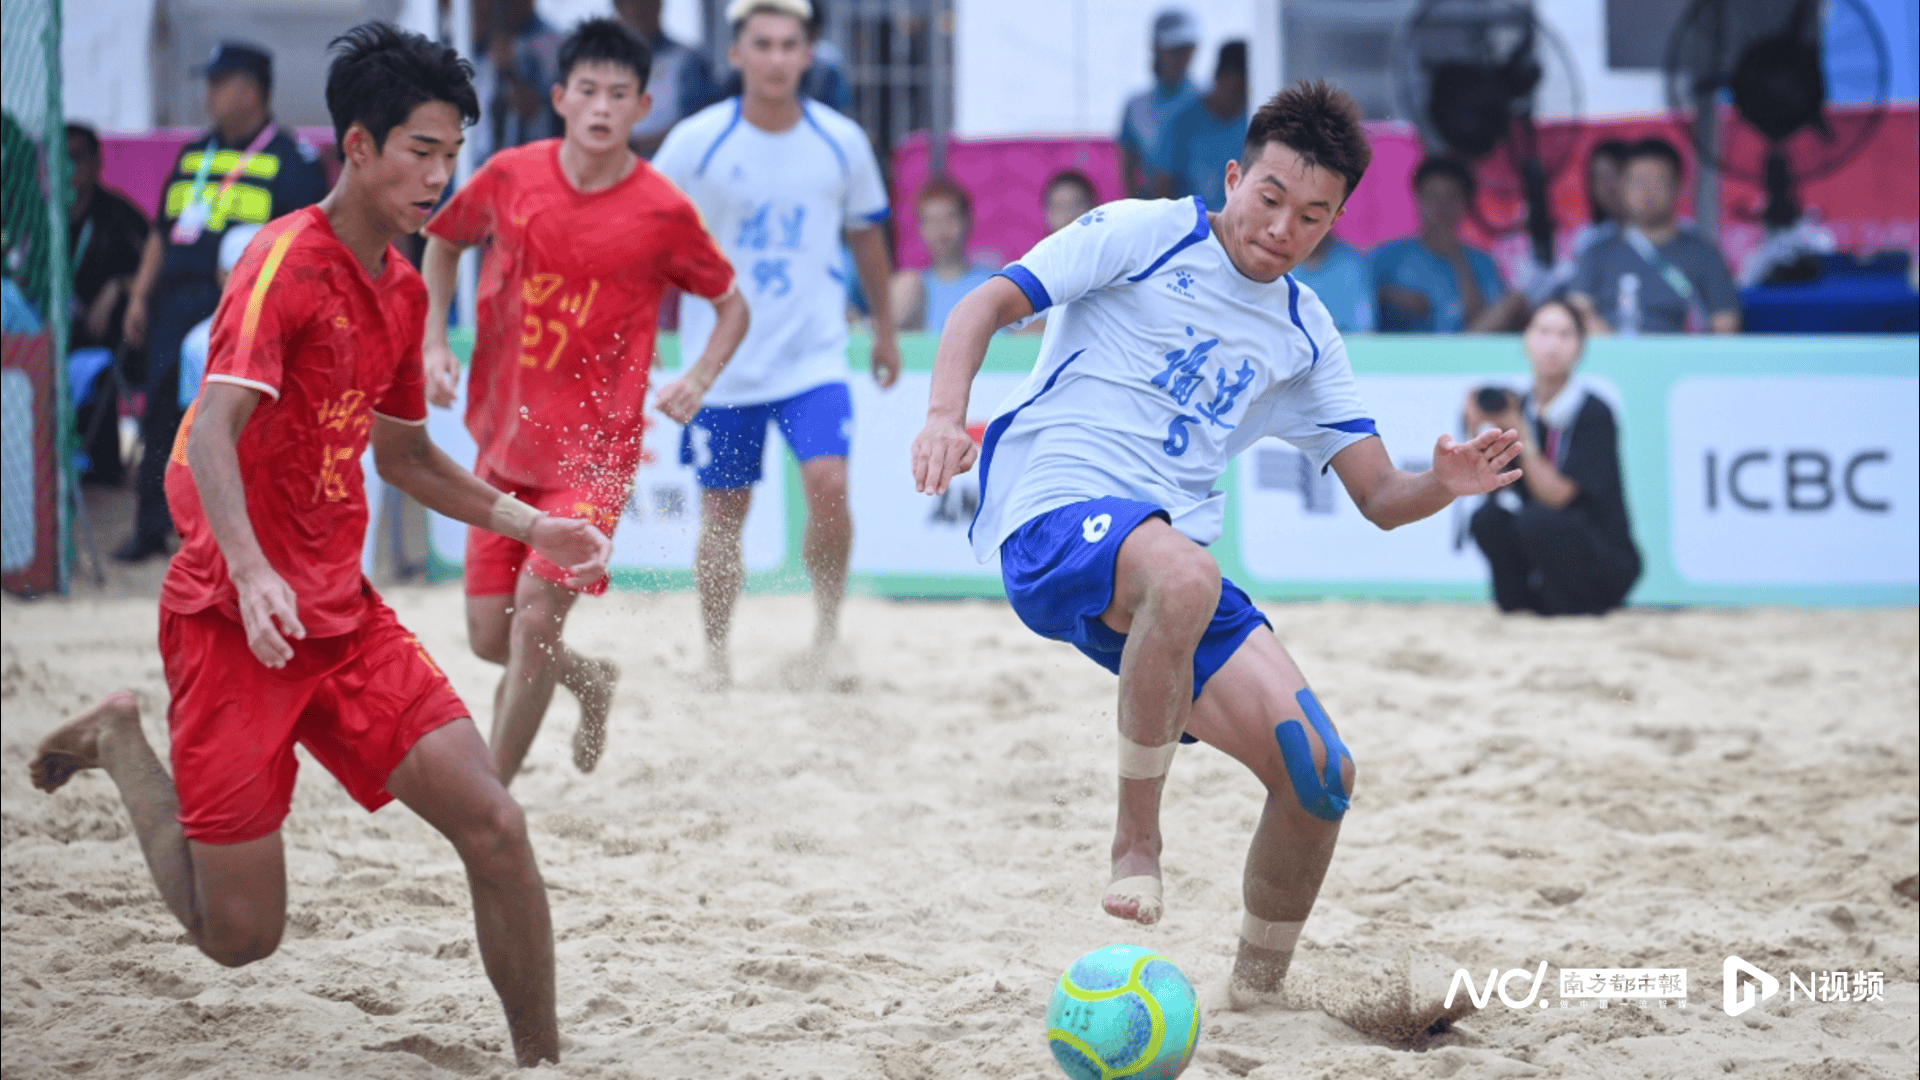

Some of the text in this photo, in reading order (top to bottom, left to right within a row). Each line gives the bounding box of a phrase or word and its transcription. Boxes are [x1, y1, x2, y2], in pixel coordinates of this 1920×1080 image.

[521, 272, 599, 328] 四川
[751, 258, 792, 298] 95
[518, 314, 569, 370] 27
[1150, 325, 1256, 430] 福建
[1162, 414, 1200, 458] 6
[1705, 449, 1892, 514] ICBC
[1081, 512, 1113, 544] 6
